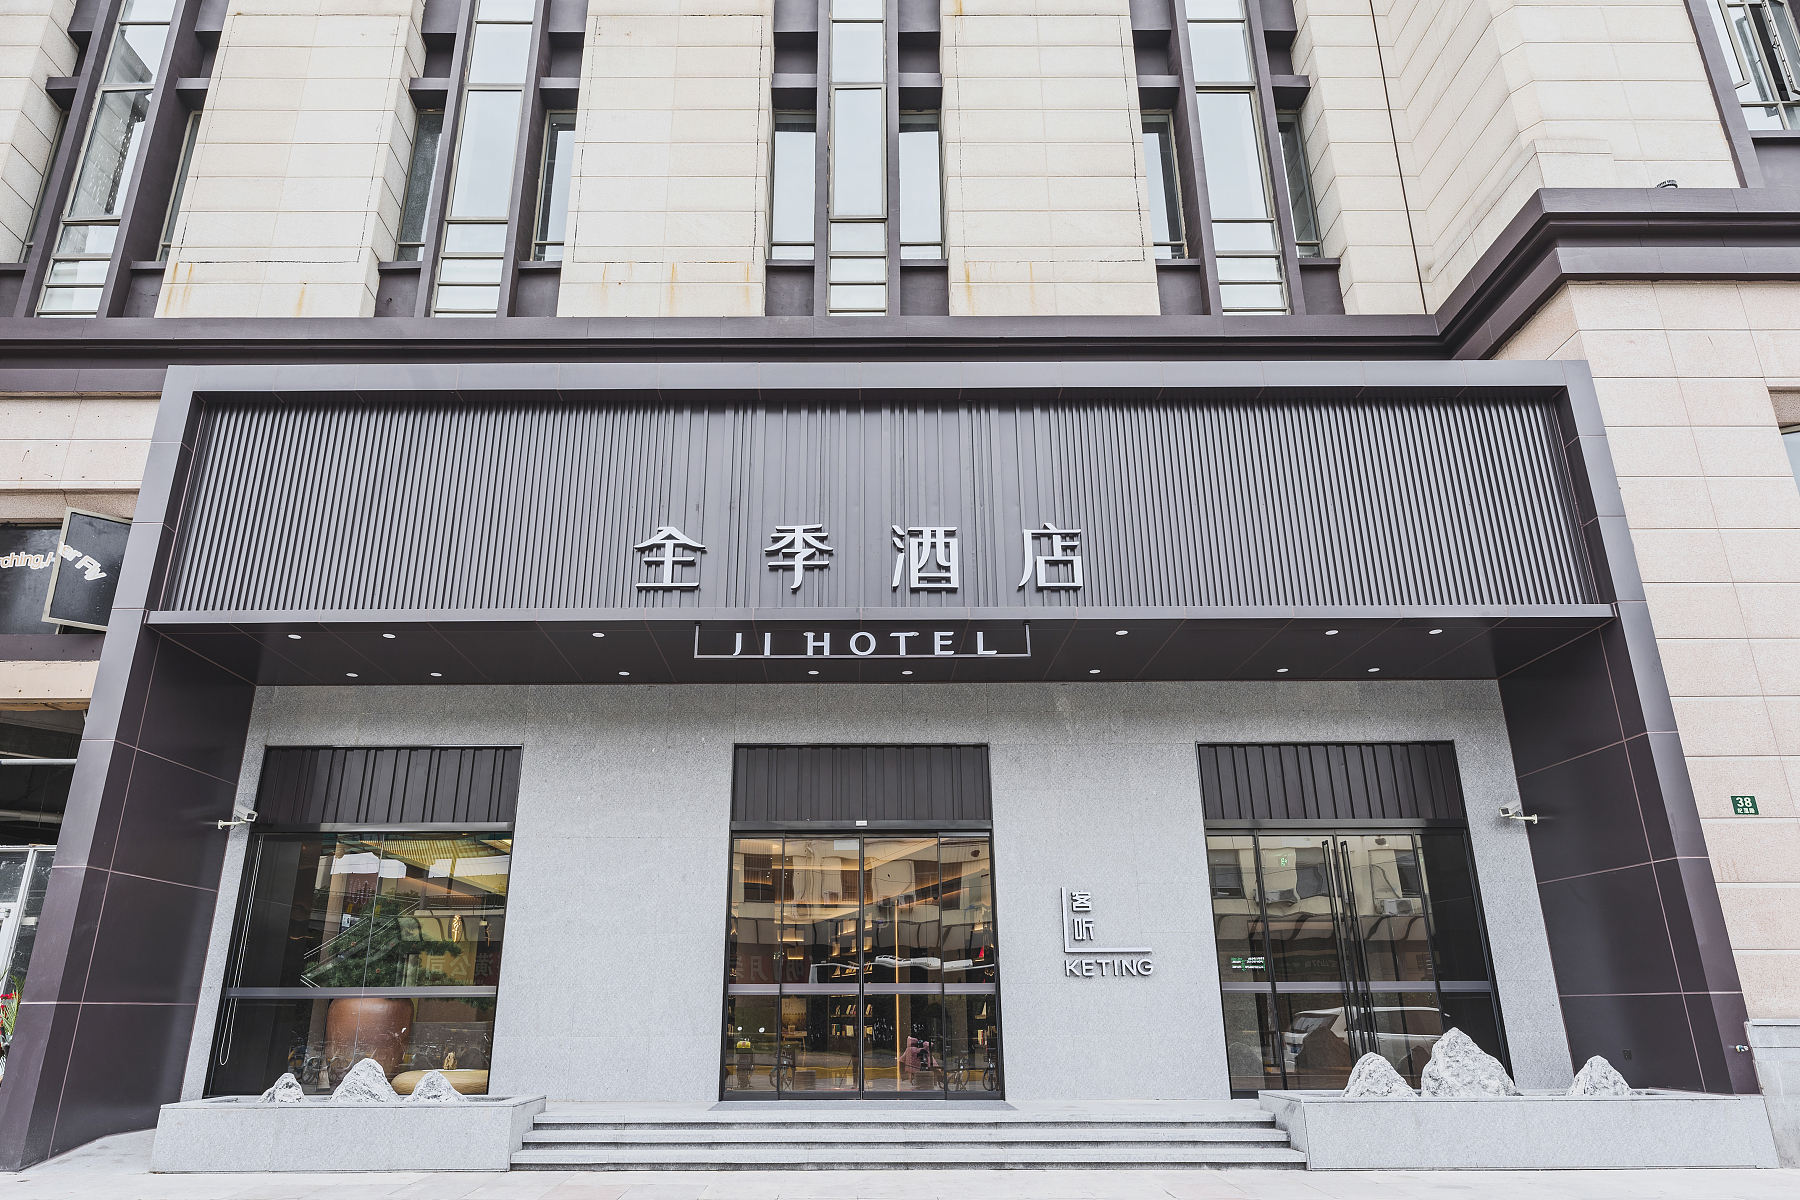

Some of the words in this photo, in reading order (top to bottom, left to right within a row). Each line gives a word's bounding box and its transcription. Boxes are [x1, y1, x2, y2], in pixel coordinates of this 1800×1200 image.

[75, 555, 107, 580] Fly
[633, 522, 1083, 591] 全季酒店
[732, 632, 771, 657] JI
[806, 631, 998, 657] HOTEL
[1735, 797, 1753, 807] 38
[1065, 959, 1154, 977] KETING
